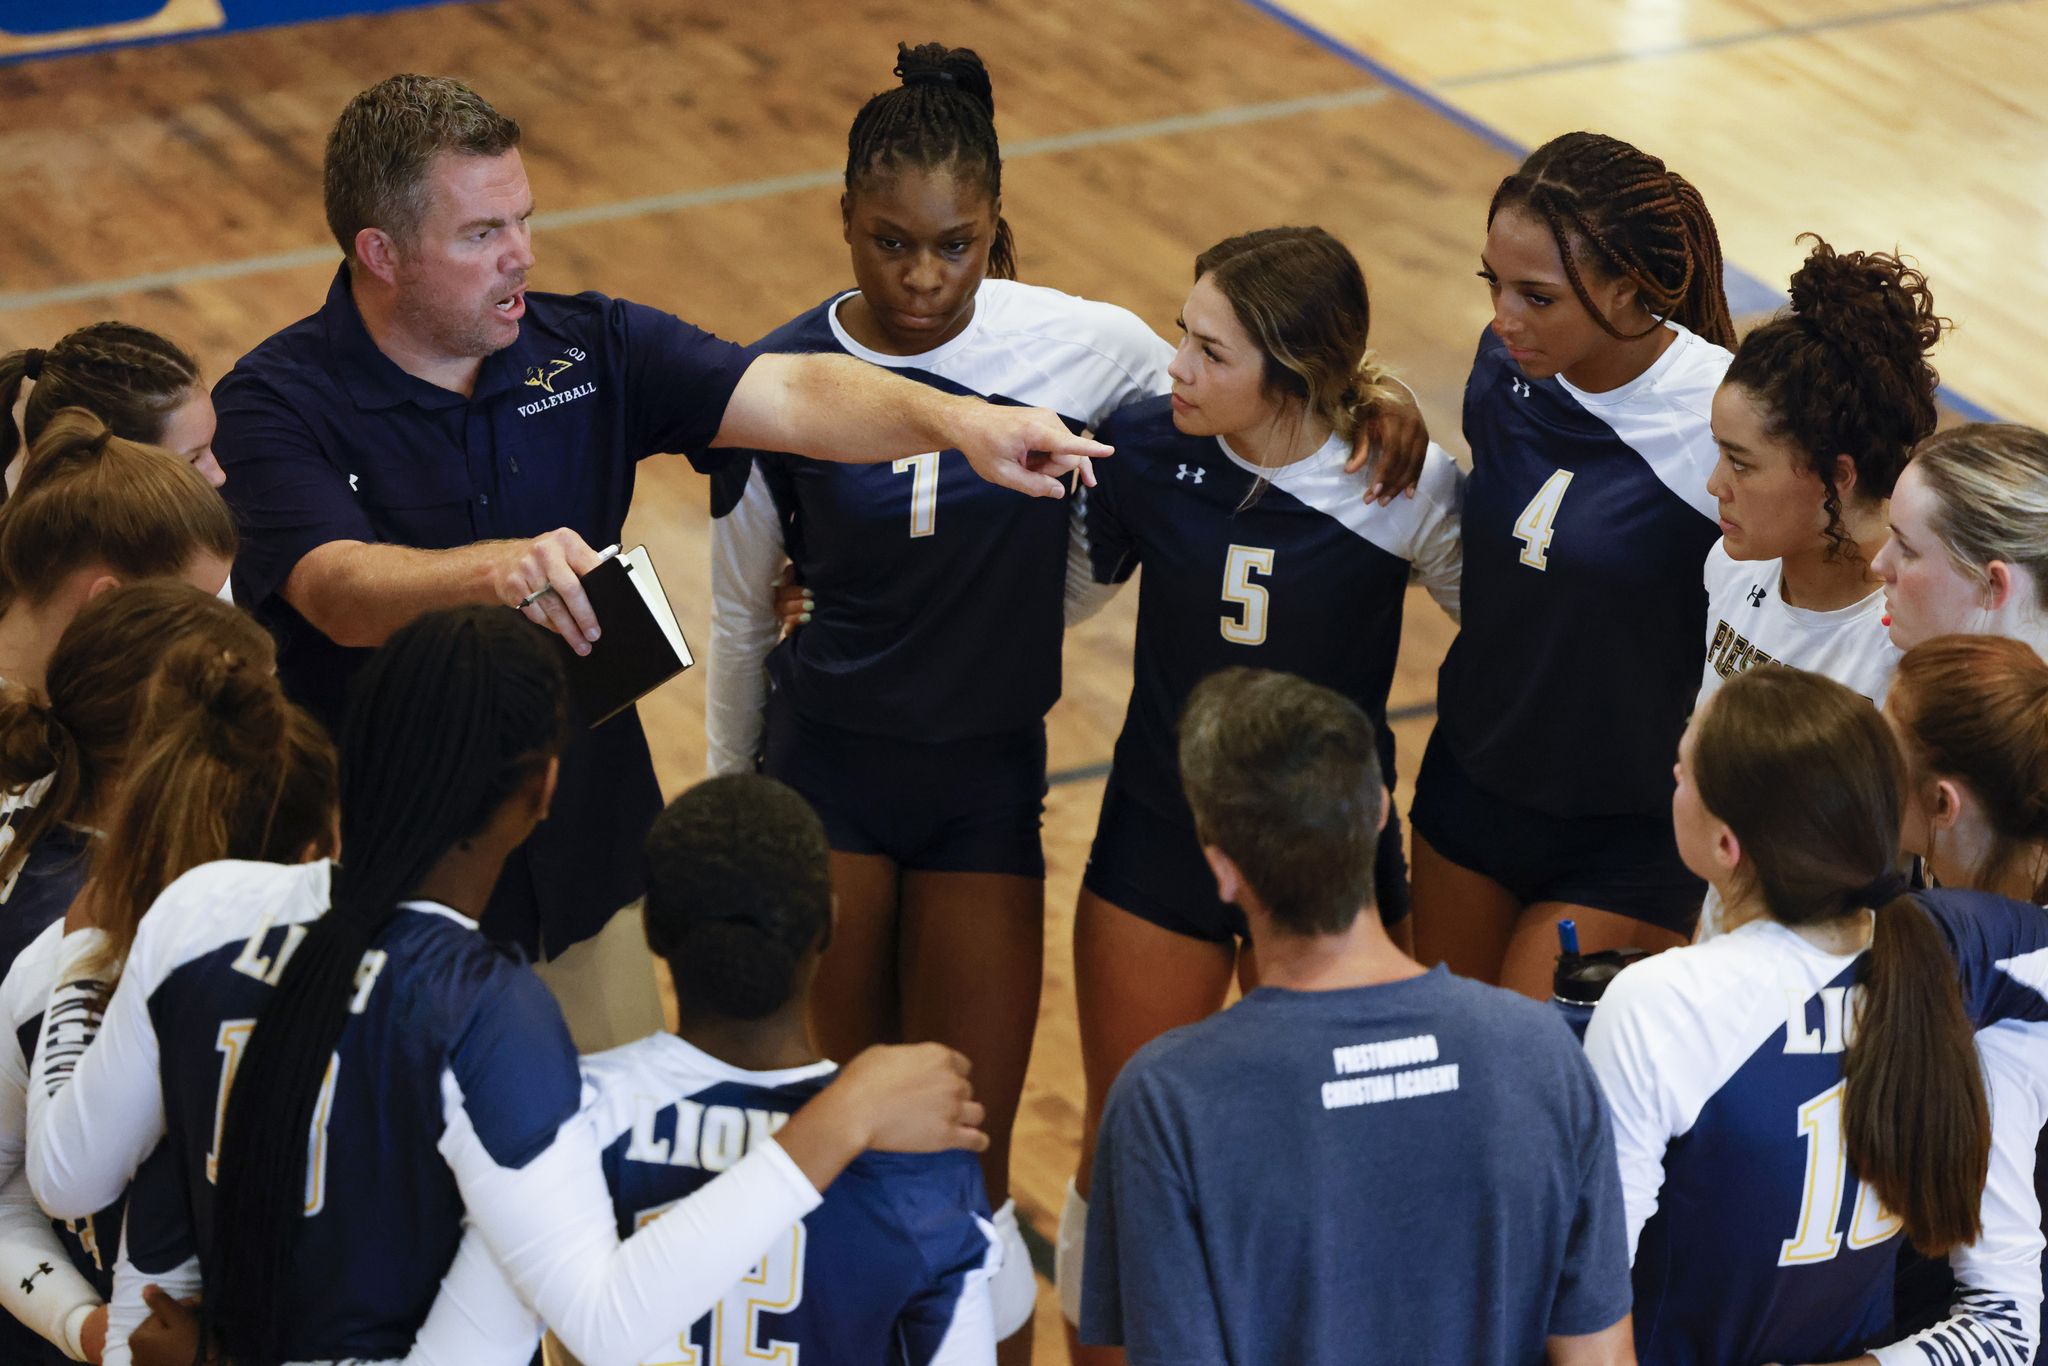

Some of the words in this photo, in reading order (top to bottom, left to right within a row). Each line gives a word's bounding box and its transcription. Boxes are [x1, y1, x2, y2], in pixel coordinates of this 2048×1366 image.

[517, 382, 597, 417] VOLLEYBALL
[892, 451, 940, 538] 7
[1512, 468, 1574, 572] 4
[1220, 543, 1275, 646] 5
